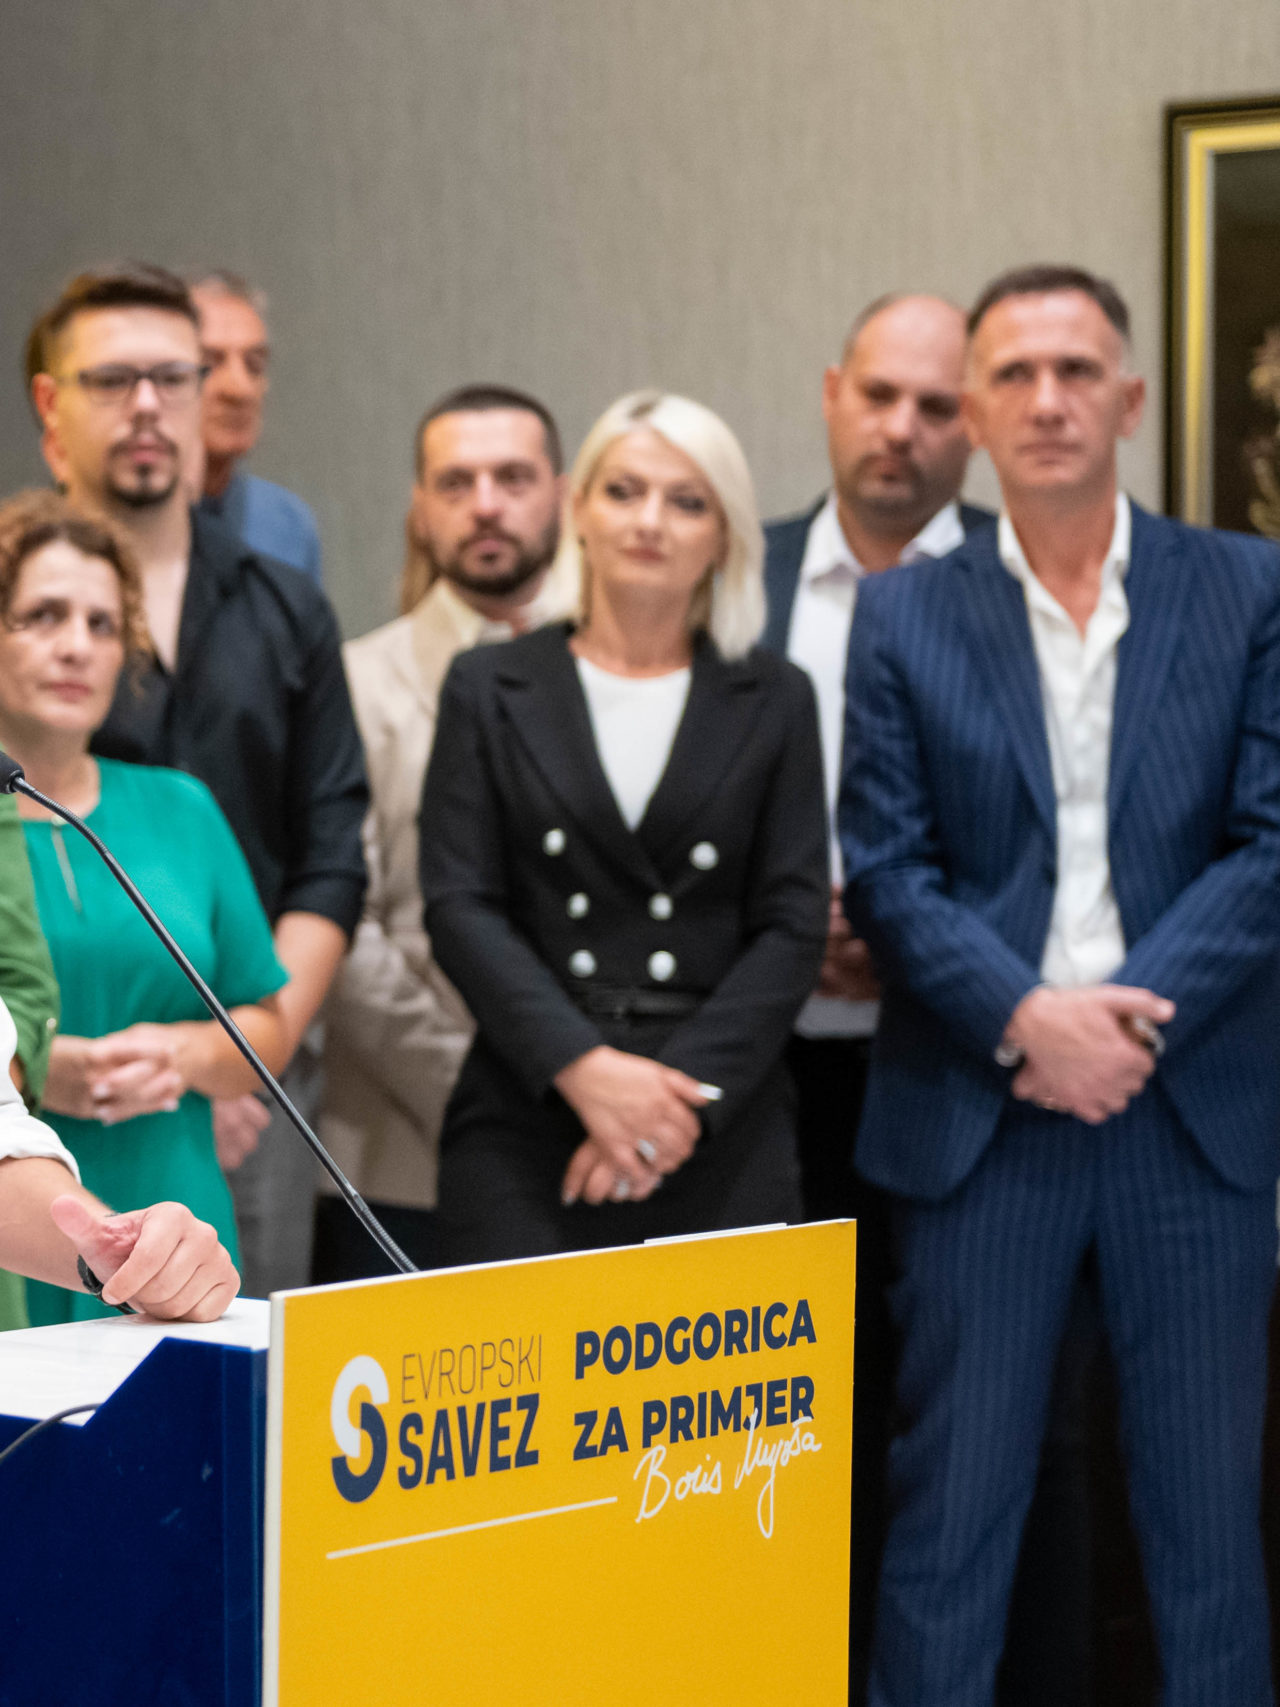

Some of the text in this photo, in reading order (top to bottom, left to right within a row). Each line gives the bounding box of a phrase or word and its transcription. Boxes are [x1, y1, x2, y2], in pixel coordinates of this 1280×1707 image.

[401, 1334, 543, 1404] EVROPSKI
[575, 1299, 817, 1380] PODGORICA
[397, 1393, 541, 1490] SAVEZ
[573, 1376, 815, 1461] ZA PRIMJER
[634, 1445, 722, 1523] Boris
